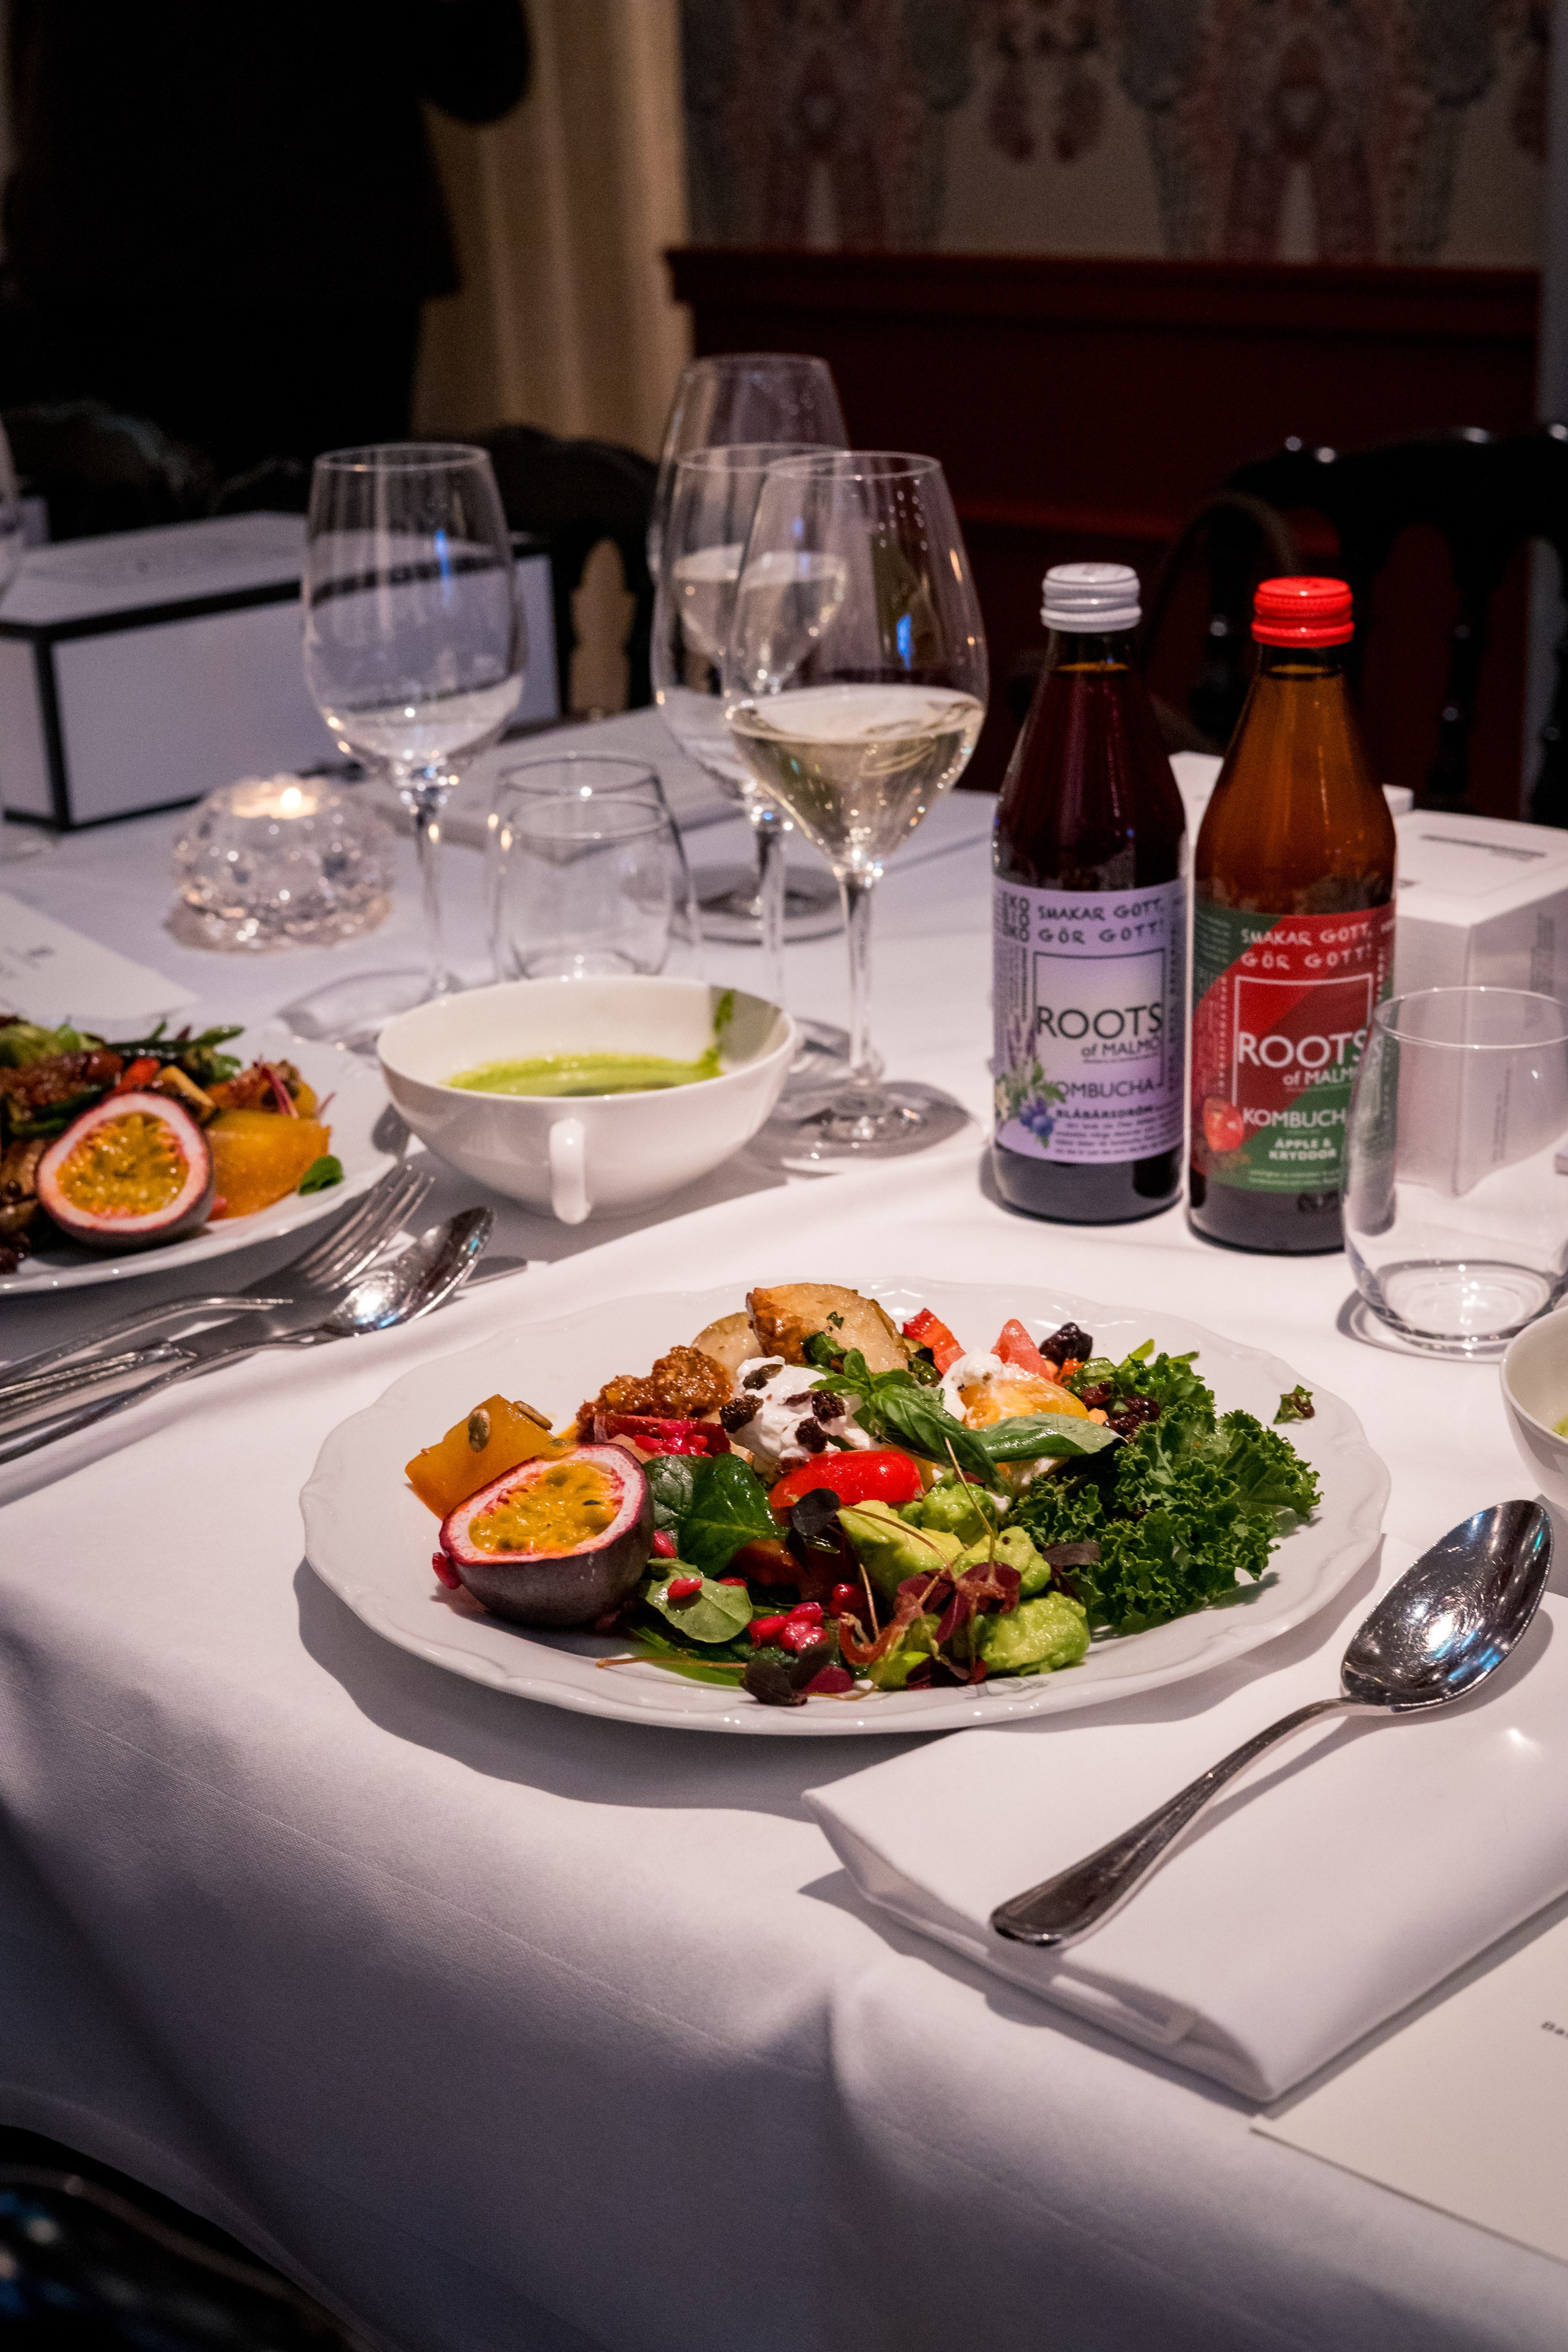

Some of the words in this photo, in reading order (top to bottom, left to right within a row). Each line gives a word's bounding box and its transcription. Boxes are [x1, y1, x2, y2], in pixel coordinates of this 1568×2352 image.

[1038, 905, 1105, 921] SMAKAR
[1038, 925, 1085, 945] GÖR
[1240, 928, 1313, 946] SMAKAR
[1241, 949, 1290, 970] GÖR
[1036, 1002, 1163, 1039] ROOTS
[1080, 1043, 1097, 1057] of
[1055, 1078, 1154, 1099] OMBUCHA
[1282, 1071, 1301, 1087] of
[1243, 1107, 1347, 1128] KOMBUCH
